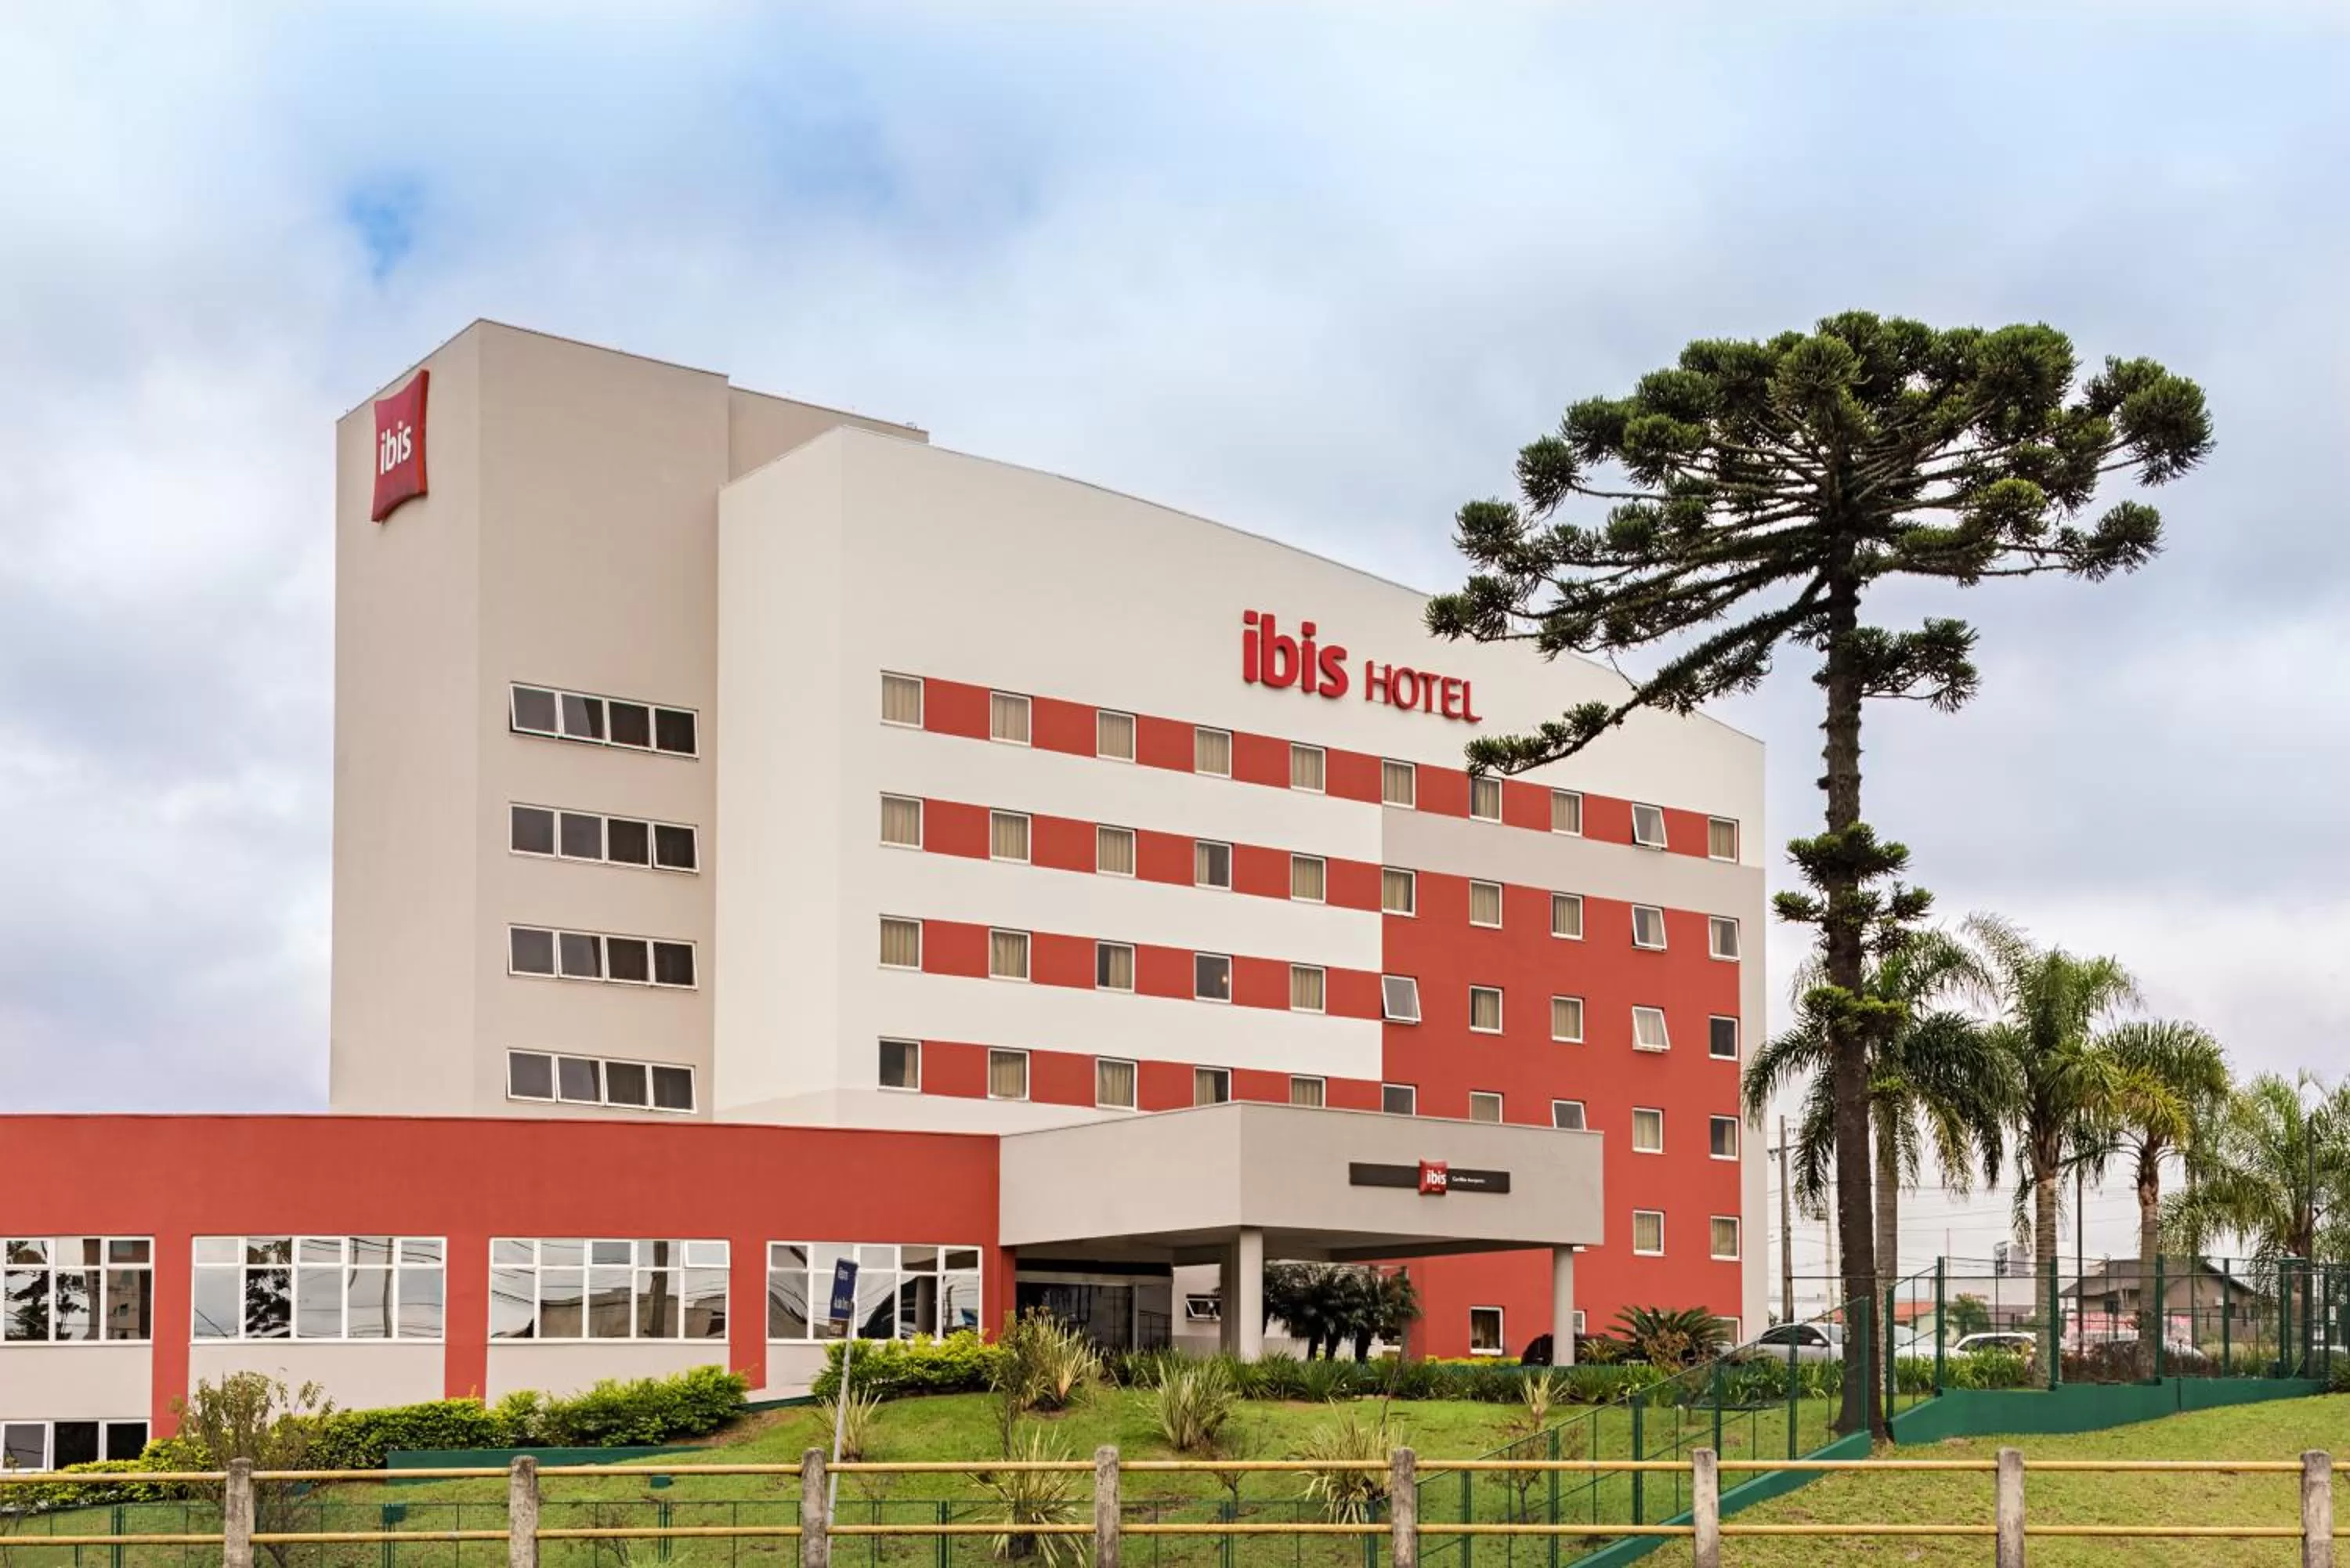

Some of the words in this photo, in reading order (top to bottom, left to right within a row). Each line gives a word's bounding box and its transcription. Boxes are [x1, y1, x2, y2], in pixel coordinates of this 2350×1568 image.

[380, 421, 411, 475] ibis
[1243, 609, 1349, 699] ibis
[1365, 660, 1482, 723] HOTEL
[1426, 1169, 1447, 1185] ibis
